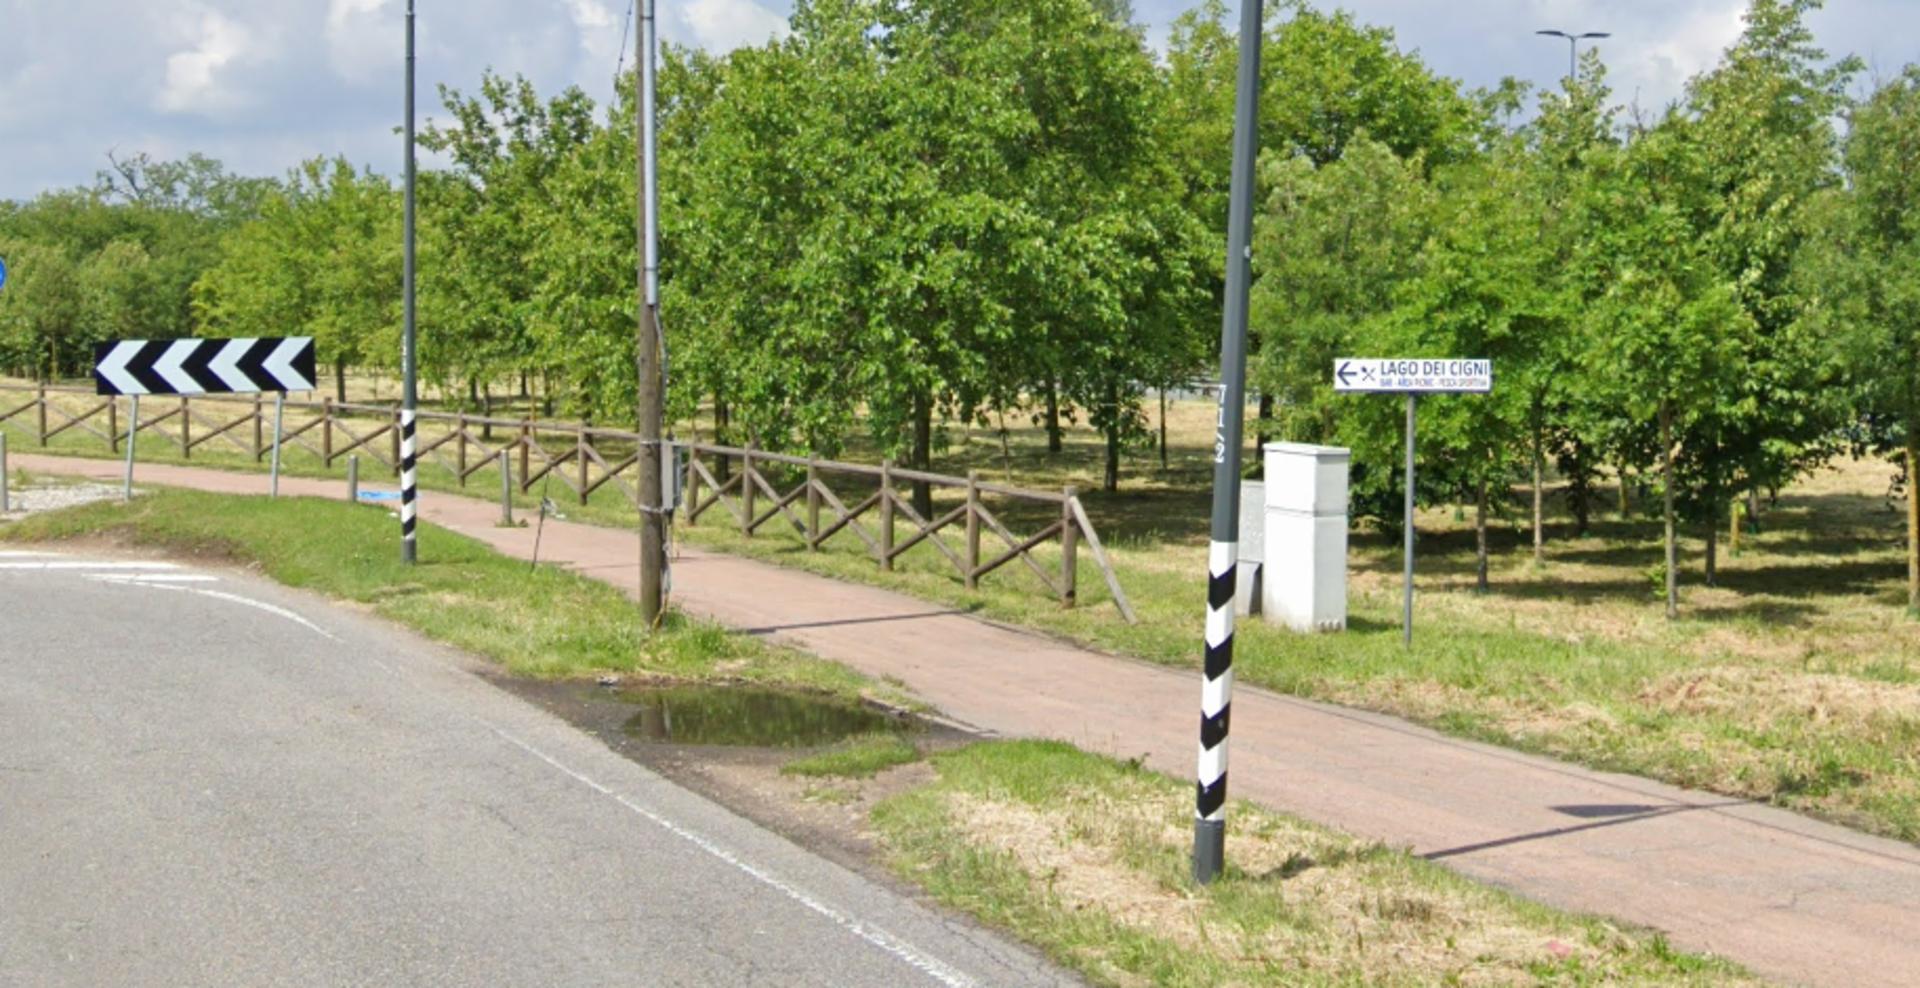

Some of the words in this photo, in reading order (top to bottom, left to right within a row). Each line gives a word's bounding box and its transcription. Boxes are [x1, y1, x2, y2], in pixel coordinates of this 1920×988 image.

[1381, 361, 1418, 375] LAGO
[1423, 361, 1445, 375] DEI
[1450, 361, 1488, 375] CIGNI
